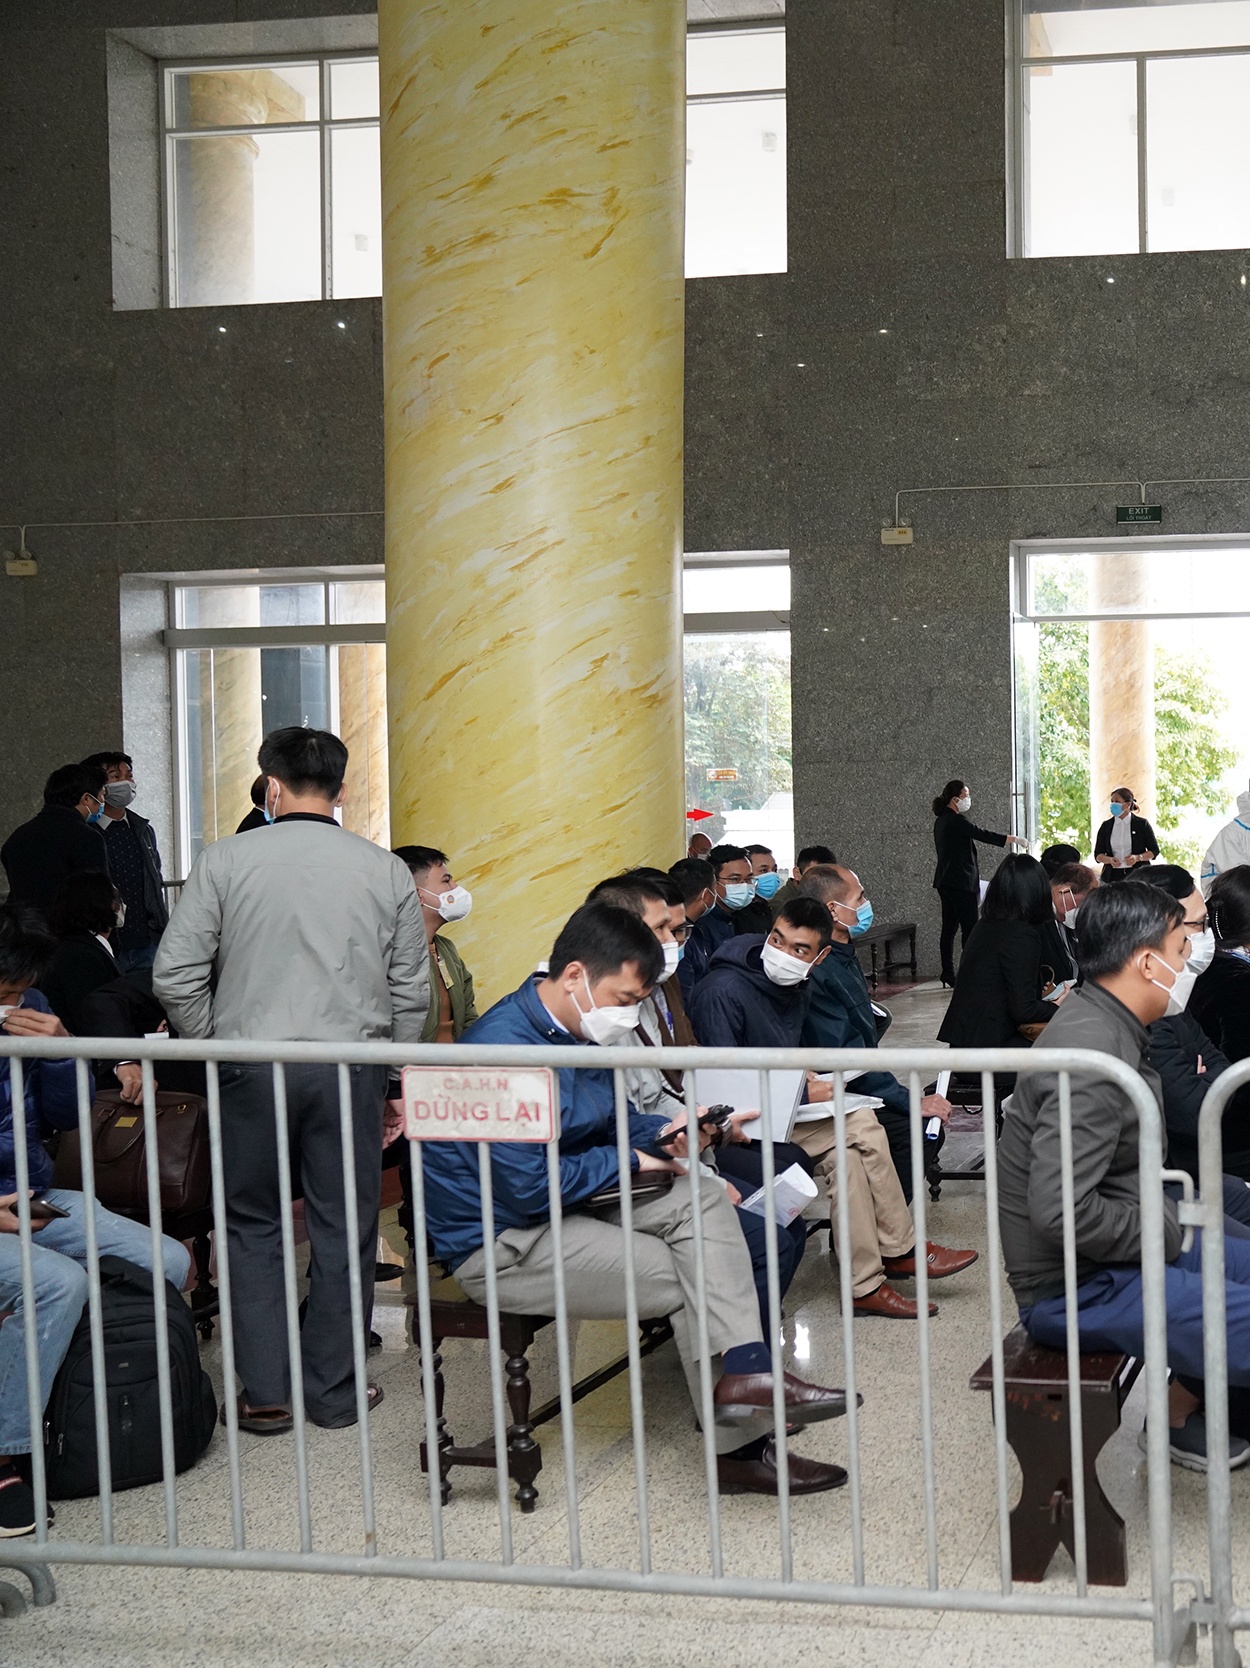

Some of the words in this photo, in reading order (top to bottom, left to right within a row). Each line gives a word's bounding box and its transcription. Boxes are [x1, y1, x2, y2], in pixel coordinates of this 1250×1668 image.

[1128, 507, 1149, 515] EXIT
[443, 1077, 509, 1091] C.A.H.N
[414, 1094, 489, 1121] DỪNG
[496, 1101, 541, 1127] LẠI
